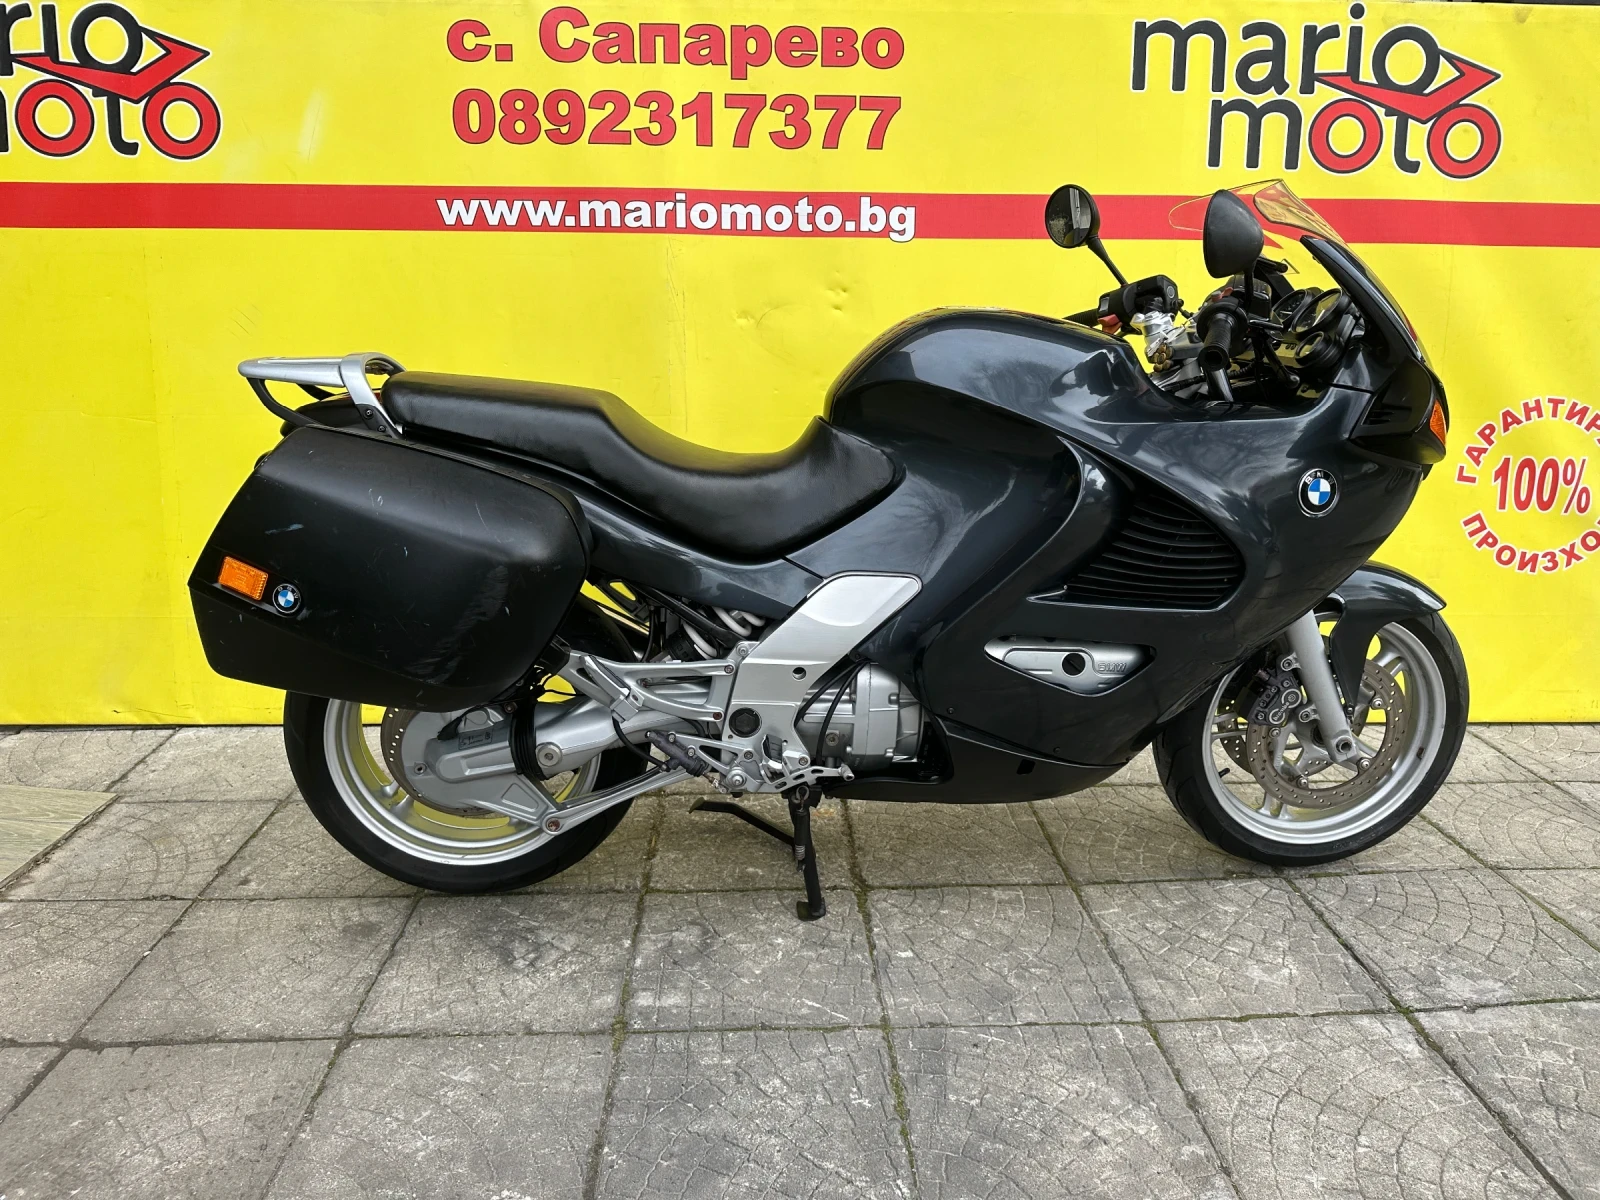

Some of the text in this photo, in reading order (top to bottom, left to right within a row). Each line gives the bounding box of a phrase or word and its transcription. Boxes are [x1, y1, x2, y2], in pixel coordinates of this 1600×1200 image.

[446, 6, 905, 80] с. Сапарево
[1132, 3, 1440, 96] mario
[0, 79, 221, 160] oto
[452, 88, 902, 150] 0892317377
[1208, 98, 1501, 179] moto
[436, 192, 917, 243] www.mariomoto.bg
[1456, 397, 1600, 484] ГАРАНТИР
[1493, 457, 1591, 514] 100%
[1462, 512, 1600, 573] ПРОИЗХО
